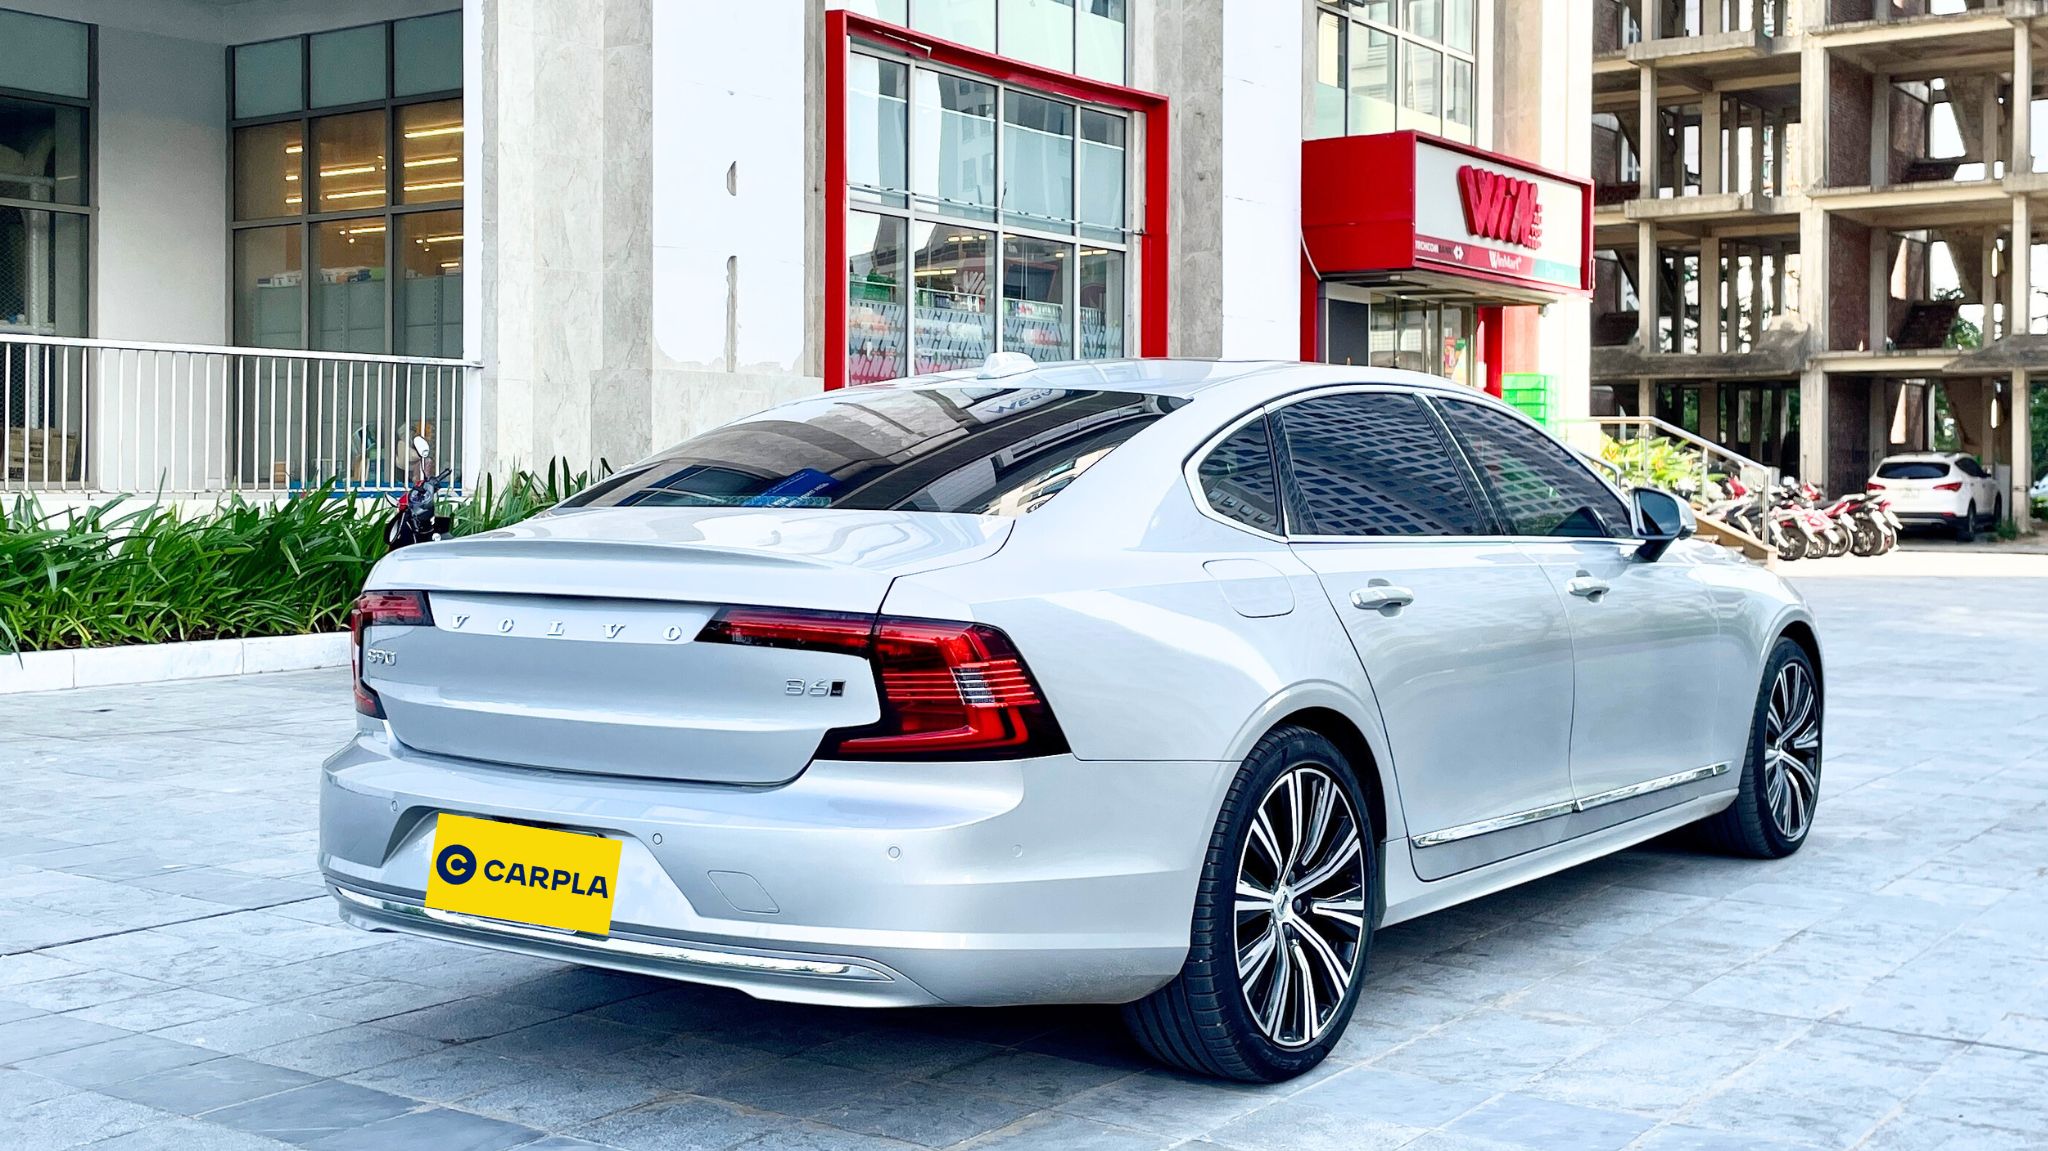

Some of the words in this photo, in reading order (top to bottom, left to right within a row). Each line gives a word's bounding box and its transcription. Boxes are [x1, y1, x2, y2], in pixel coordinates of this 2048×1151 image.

[450, 614, 683, 641] VOLVO
[367, 648, 397, 666] S90
[785, 678, 829, 697] B6
